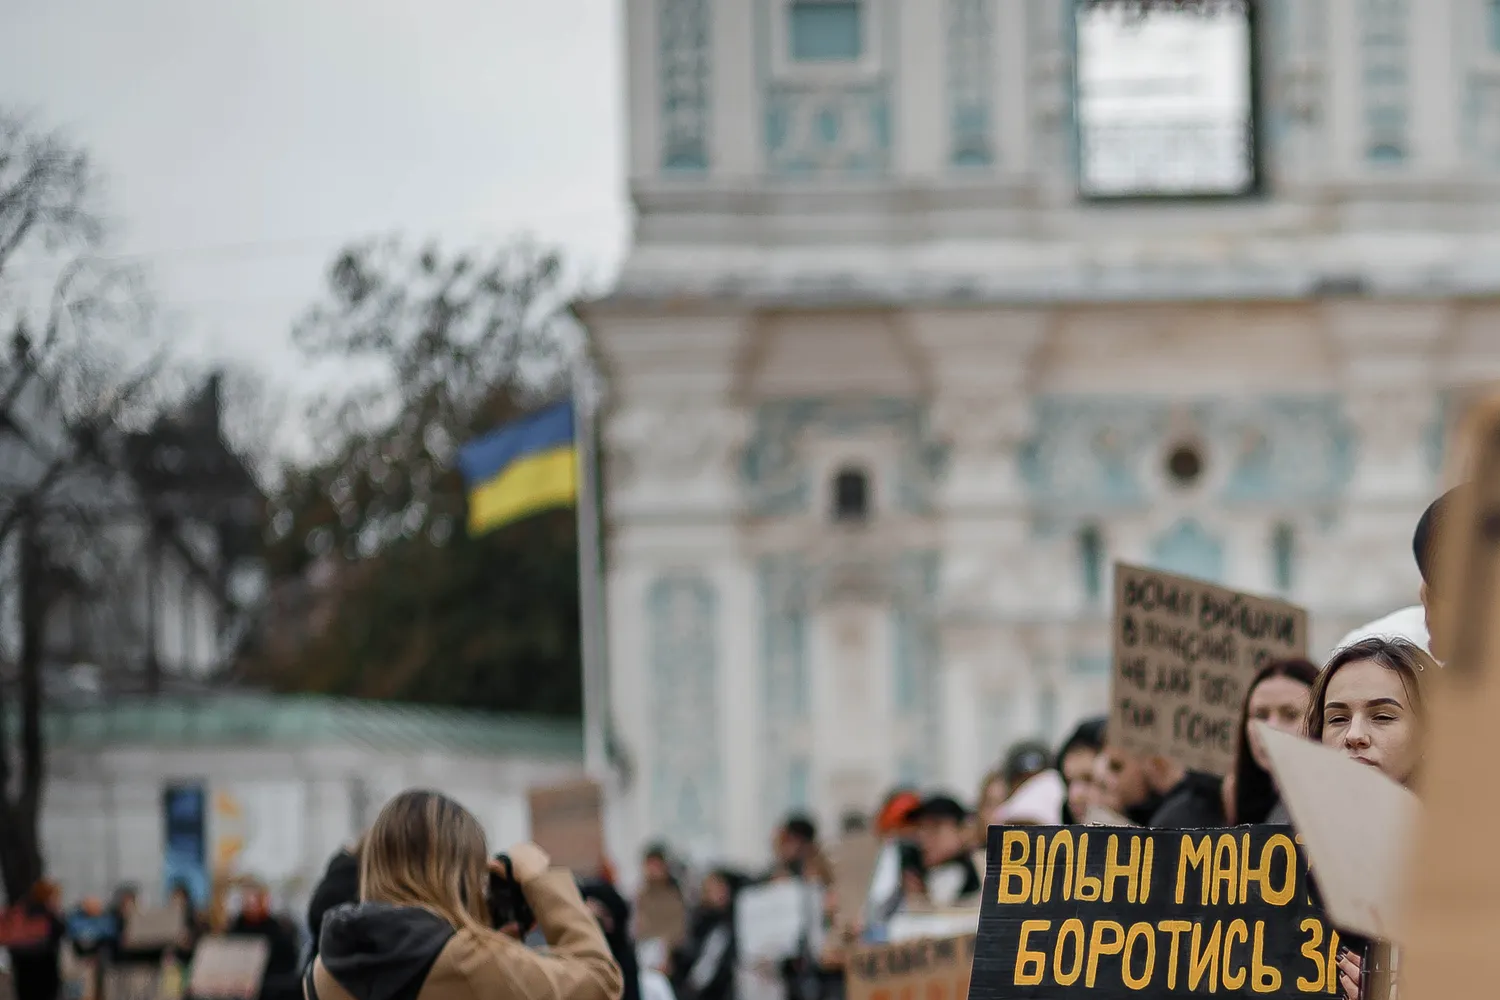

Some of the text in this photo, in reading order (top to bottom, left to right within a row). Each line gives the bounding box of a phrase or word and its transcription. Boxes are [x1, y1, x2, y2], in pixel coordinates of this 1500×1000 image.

[997, 828, 1313, 906] ВІЛЬНІ МАЮ
[1013, 918, 1282, 994] БОРОТИСЬ
